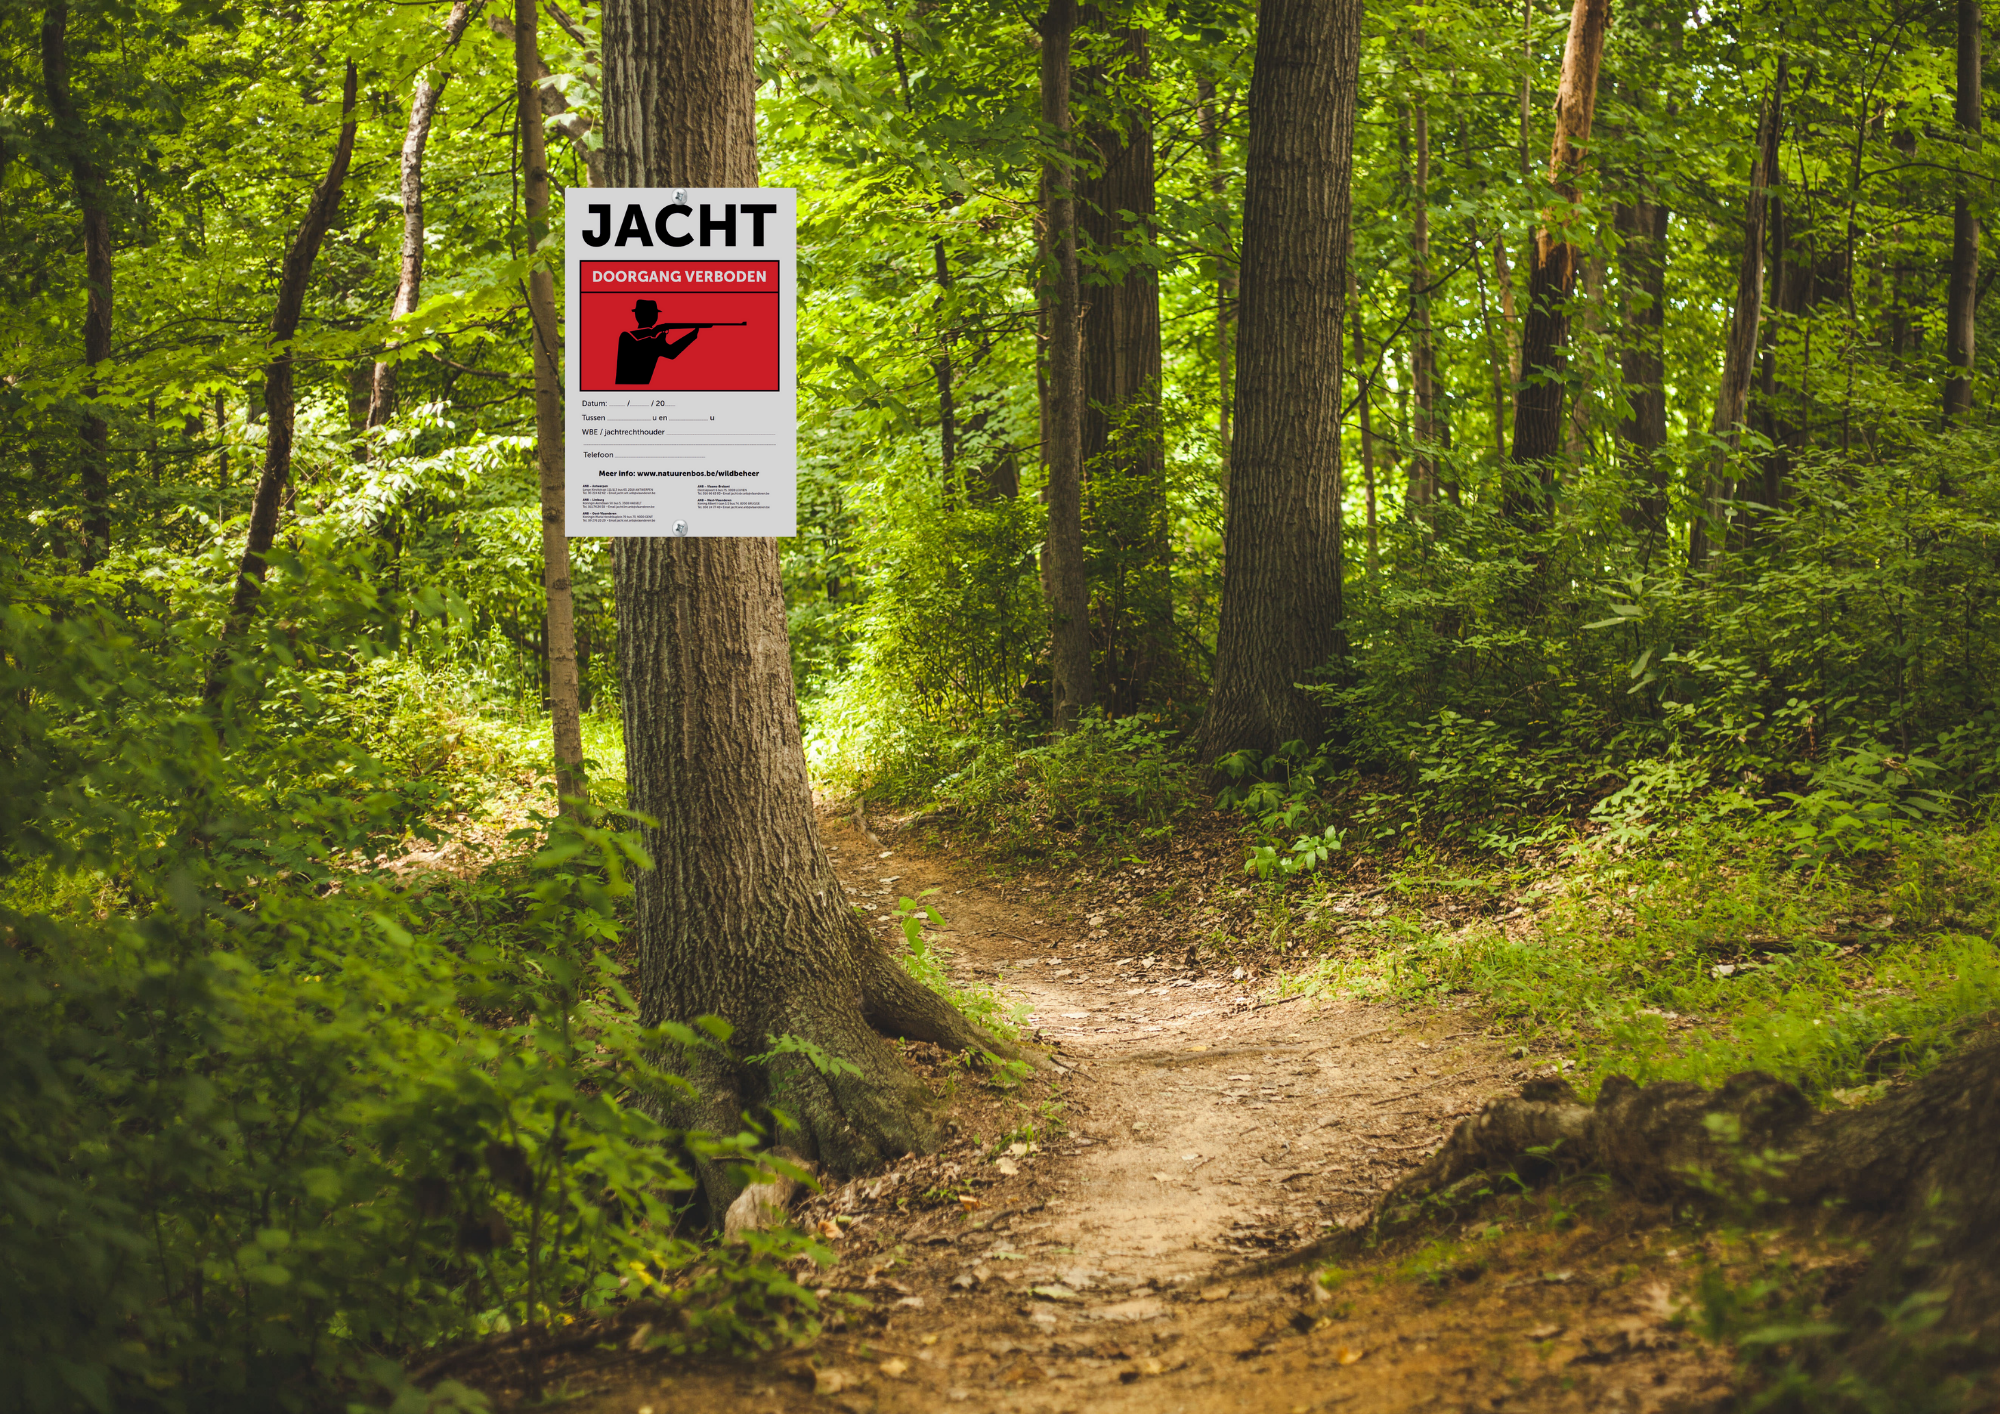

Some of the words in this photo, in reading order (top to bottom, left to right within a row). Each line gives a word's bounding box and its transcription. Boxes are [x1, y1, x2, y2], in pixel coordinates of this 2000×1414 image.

[582, 203, 777, 247] JACHT
[592, 270, 682, 283] DOORGANG
[685, 270, 767, 283] VERBODEN
[604, 429, 665, 437] jachtrechthouder
